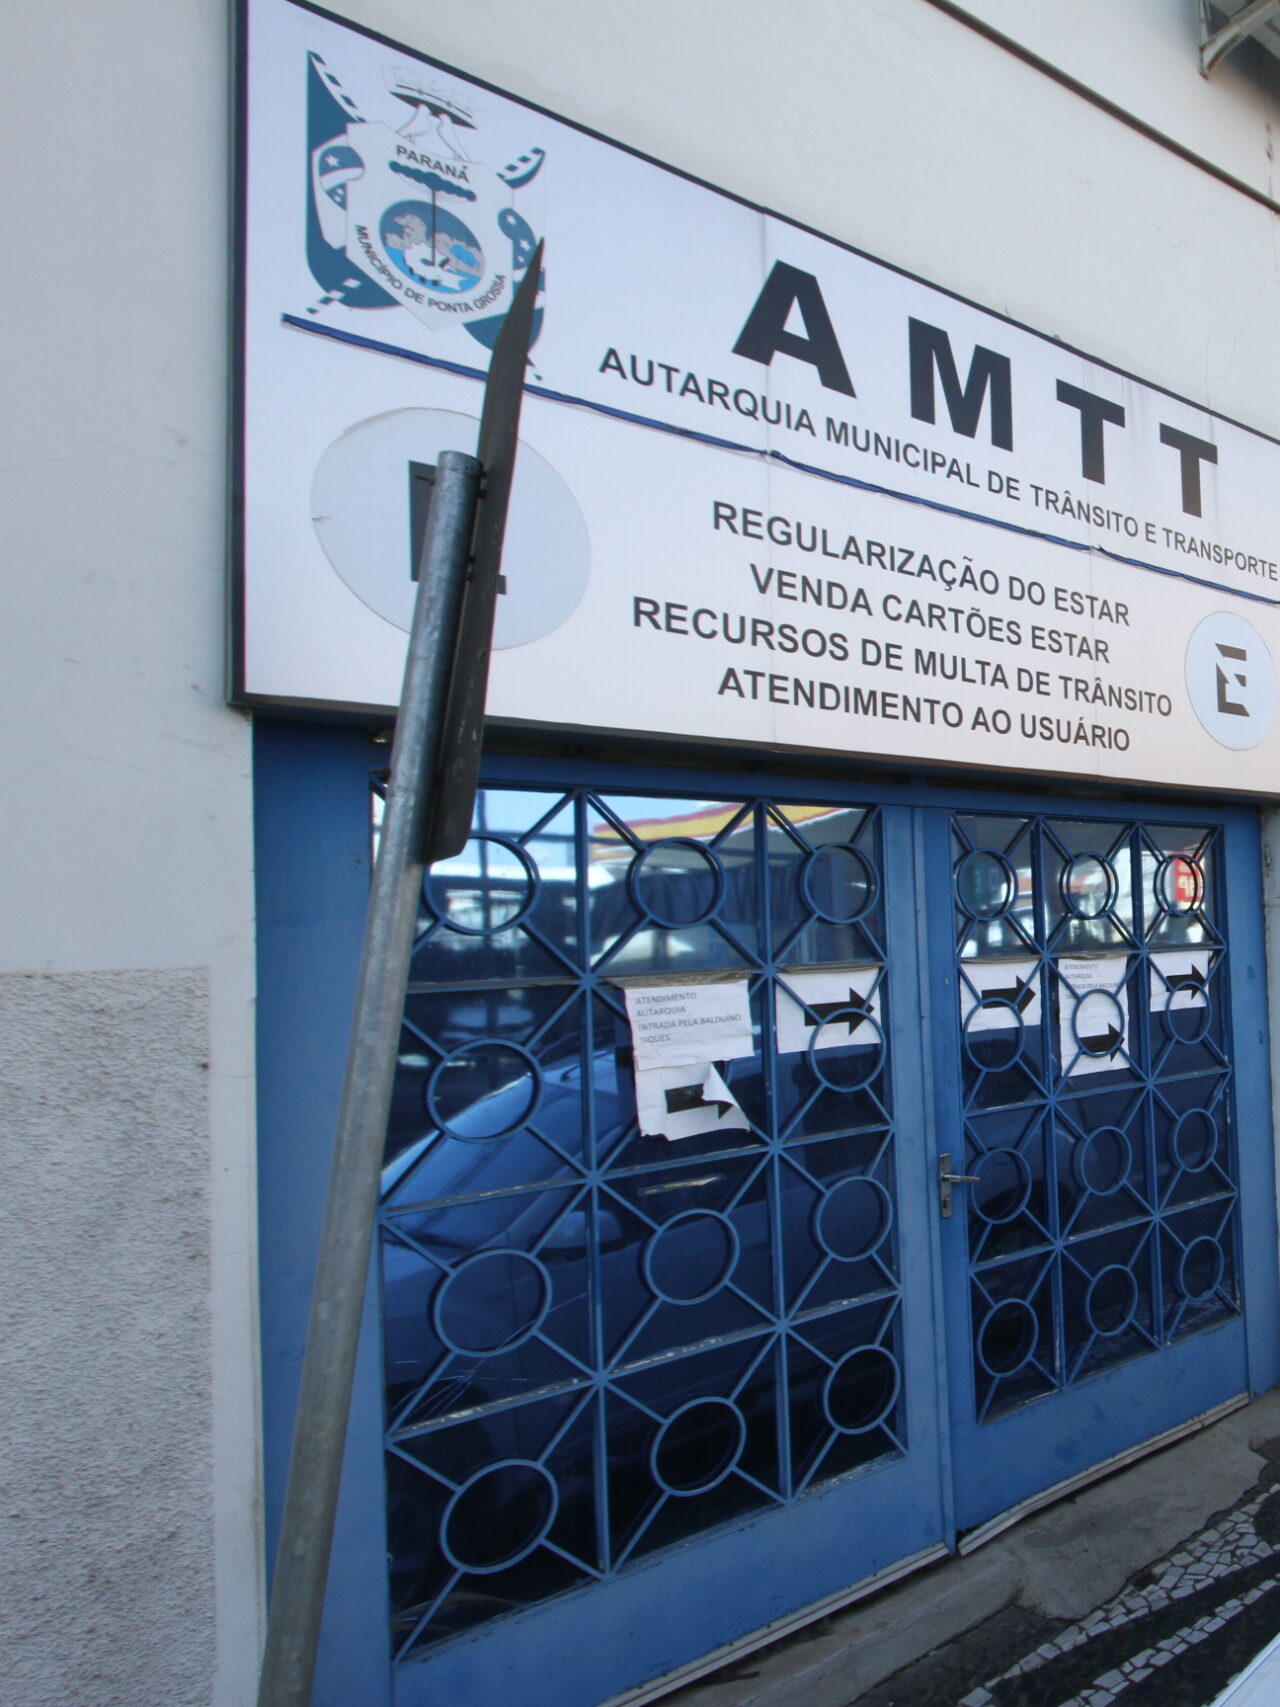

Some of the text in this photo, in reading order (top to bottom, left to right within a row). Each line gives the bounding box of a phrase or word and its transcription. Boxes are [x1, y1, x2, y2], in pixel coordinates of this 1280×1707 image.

[396, 144, 469, 183] PARANÁ
[355, 224, 506, 314] MUNICÍPIO DE PONTA GROSSA
[600, 347, 1279, 581] AUTARQUIA MUNICIPAL DE TRÂNSITO E TRANSPORTE
[713, 500, 1130, 627] REGULARIZAÇÃO DO ESTAR
[633, 596, 1173, 717] RECURSOS DE MULTA DE TRÂNSITO
[750, 563, 1110, 664] VENDA CARTÕES ESTAR
[717, 667, 1131, 752] ATENDIMENTO AO USUÁRIO
[636, 992, 697, 1005] ATENDIMENTO
[636, 1006, 687, 1018] AUTARQUIA
[678, 1017, 699, 1027] PELA
